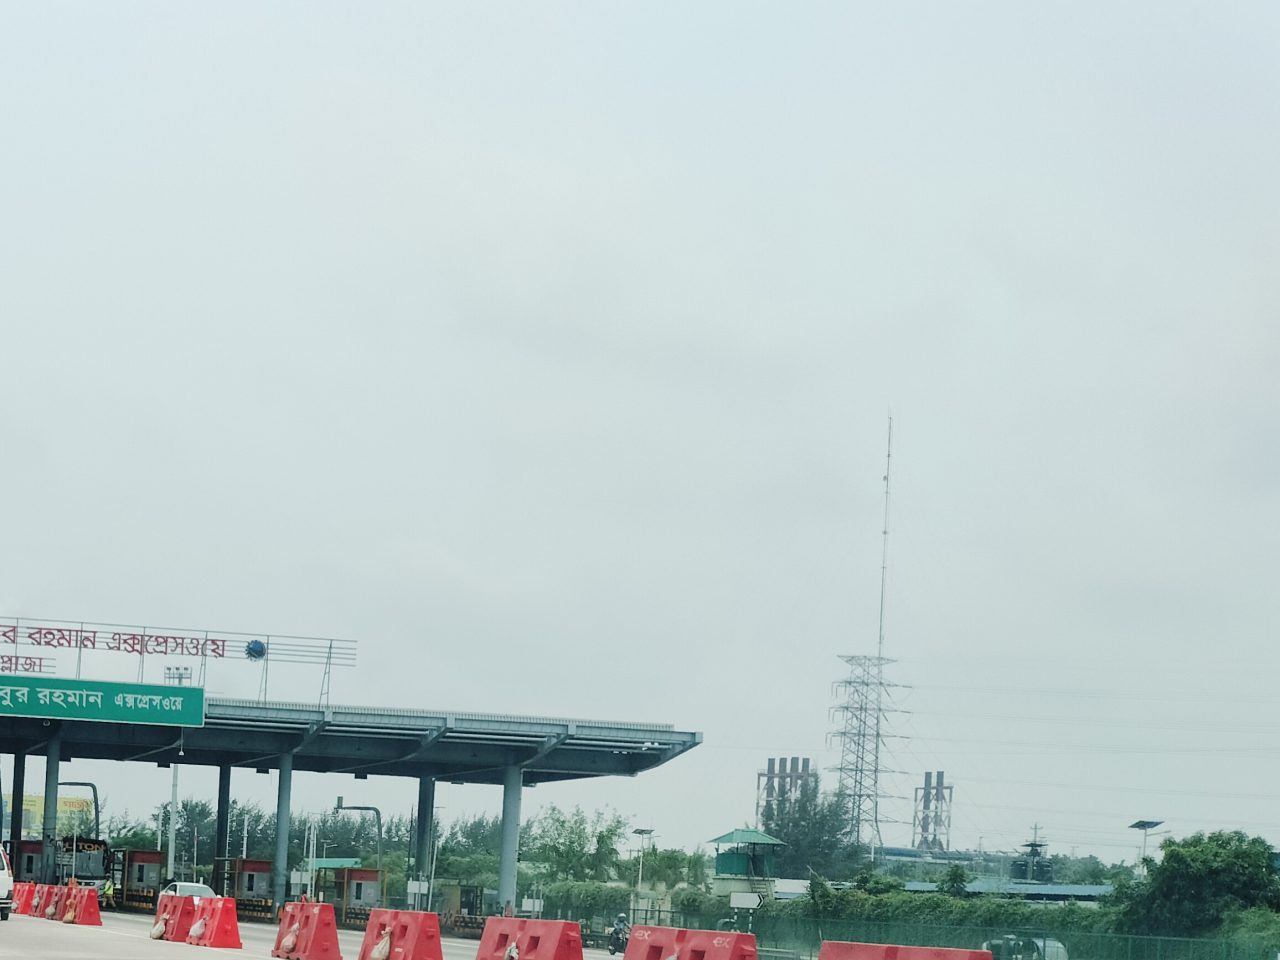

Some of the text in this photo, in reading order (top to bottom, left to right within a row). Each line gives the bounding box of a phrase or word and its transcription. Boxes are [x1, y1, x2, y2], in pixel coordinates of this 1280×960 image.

[27, 627, 98, 650] রহমান
[0, 654, 43, 673] প্লাজা
[36, 687, 104, 709] রহমান
